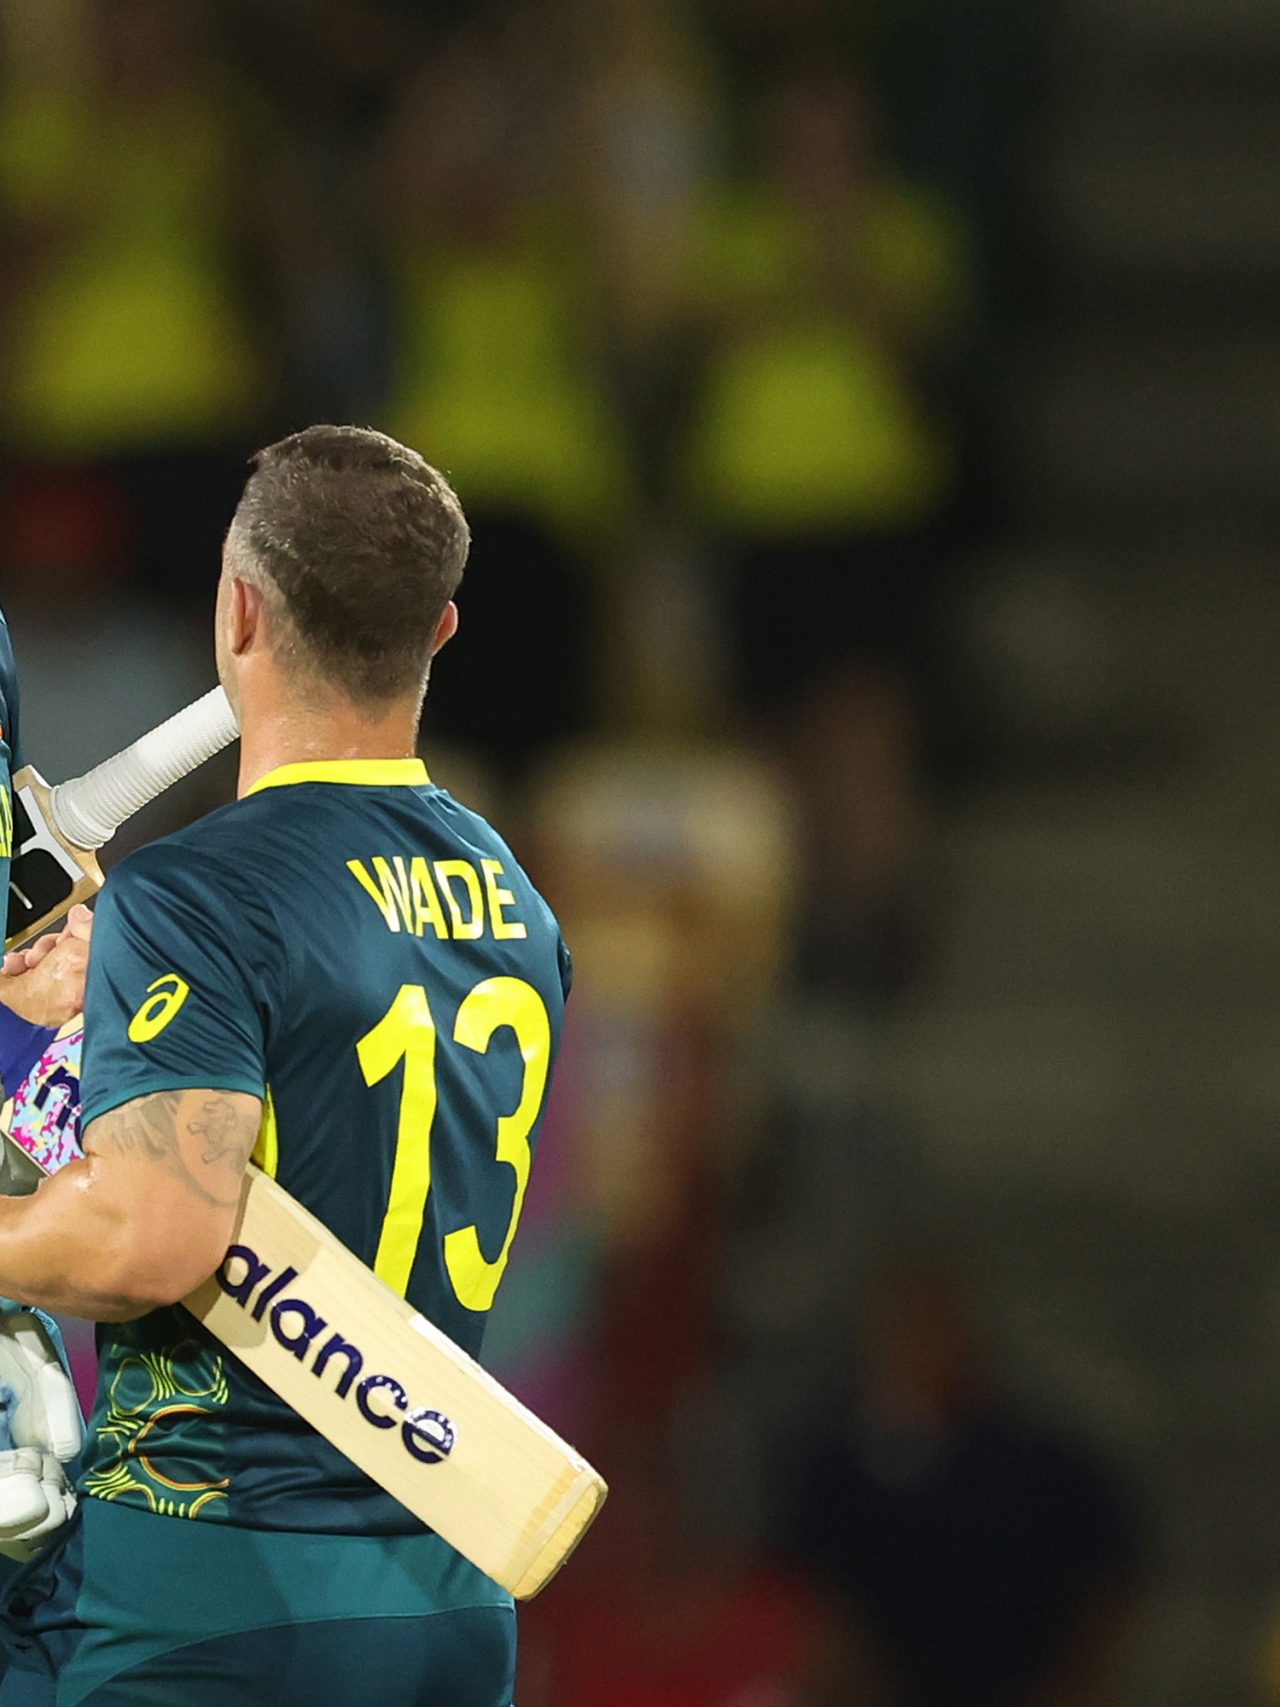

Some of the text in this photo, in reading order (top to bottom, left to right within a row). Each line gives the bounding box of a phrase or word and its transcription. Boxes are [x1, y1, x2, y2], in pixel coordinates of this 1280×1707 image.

[346, 855, 528, 941] WADE
[355, 975, 551, 1312] 13
[215, 1244, 456, 1465] alance
